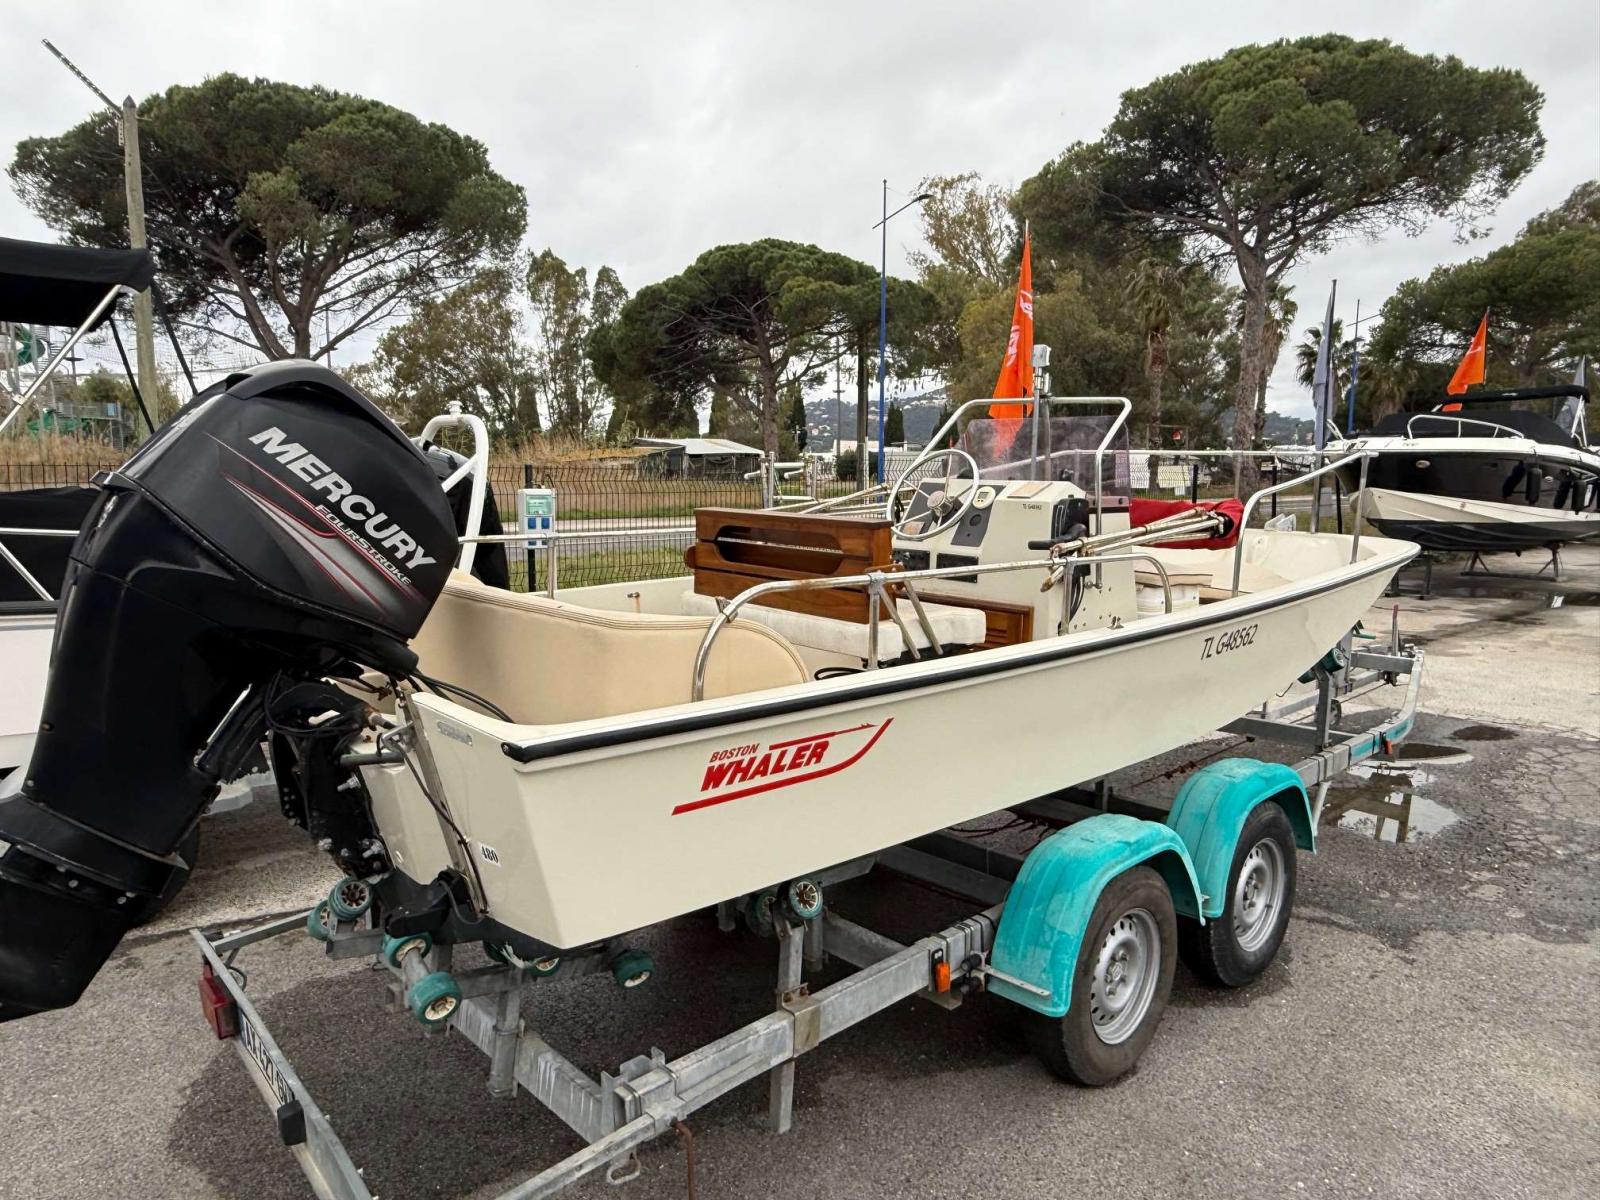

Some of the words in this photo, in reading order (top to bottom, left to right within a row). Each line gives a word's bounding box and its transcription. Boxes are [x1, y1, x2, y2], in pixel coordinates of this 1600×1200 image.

[248, 426, 437, 570] MERCURY
[315, 504, 412, 585] FOURSTROKE
[1200, 636, 1215, 660] TL
[1216, 623, 1258, 655] G48562
[700, 740, 830, 792] WHALER
[709, 743, 760, 763] BOSTON
